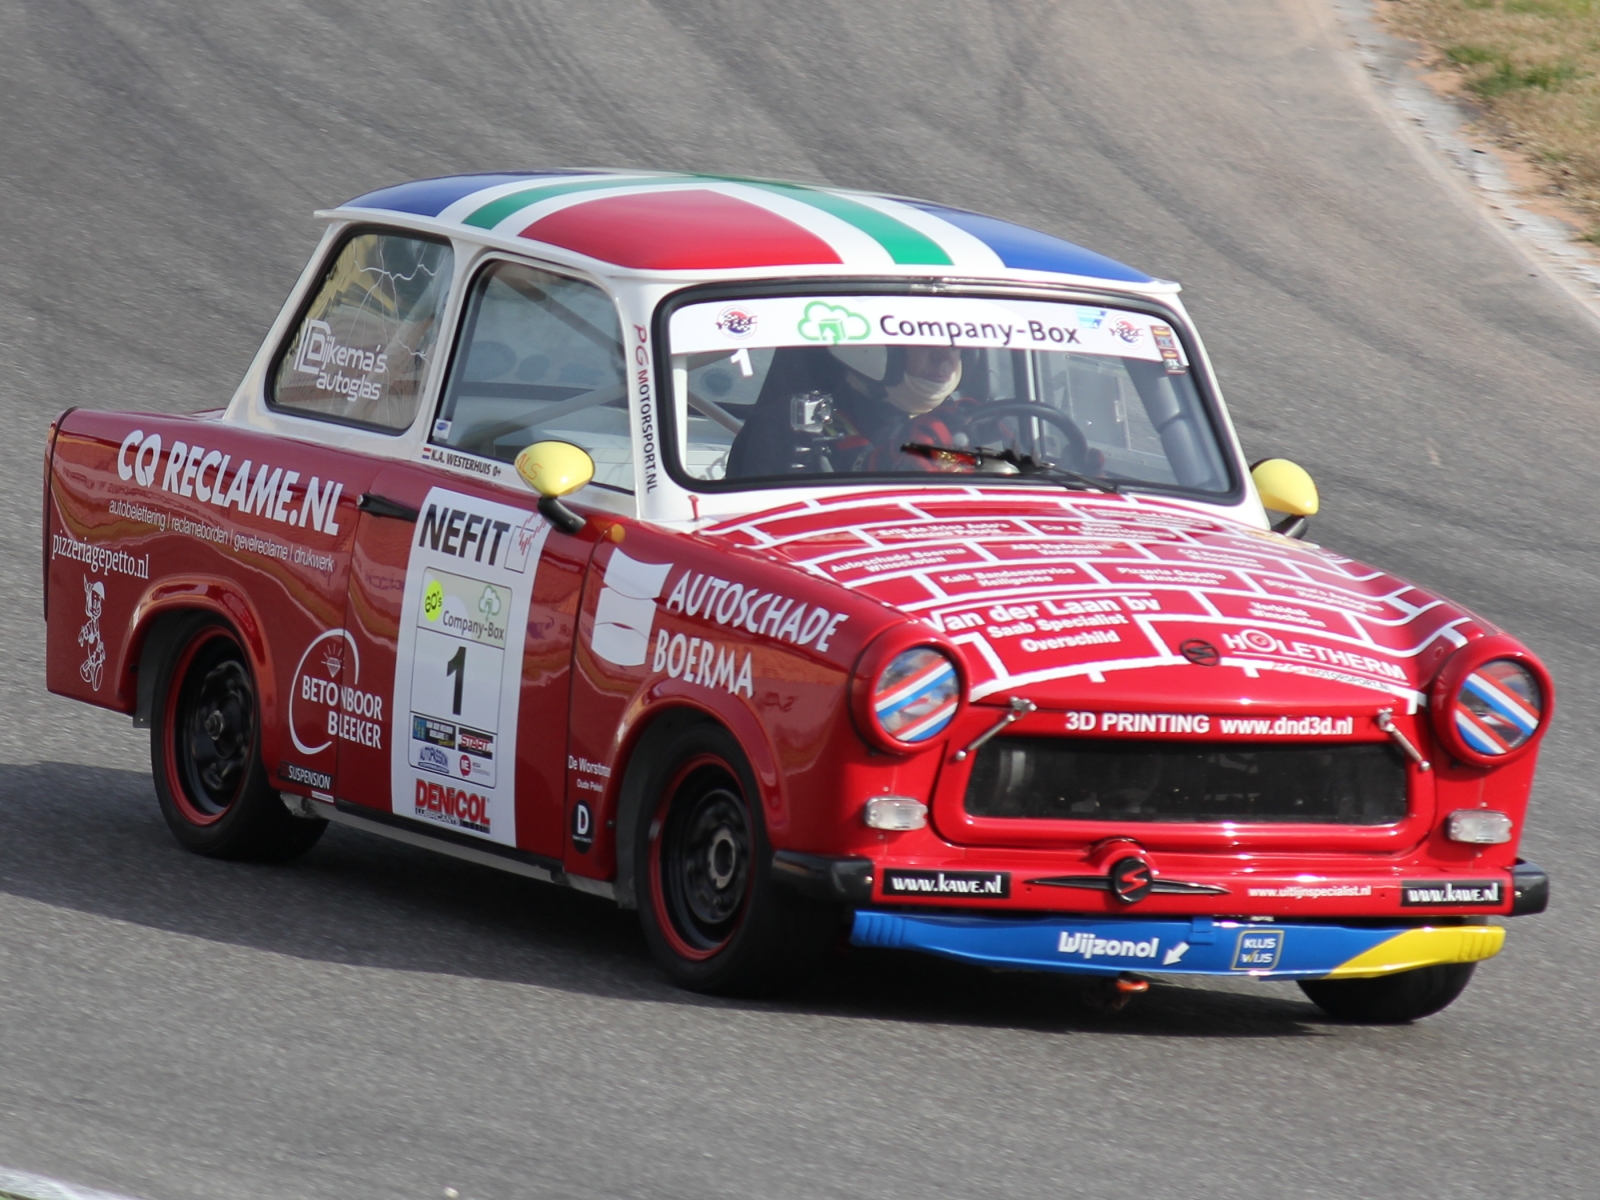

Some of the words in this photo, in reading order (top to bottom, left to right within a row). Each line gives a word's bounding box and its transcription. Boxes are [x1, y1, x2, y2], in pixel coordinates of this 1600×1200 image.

[880, 314, 1081, 346] Company-Box
[730, 348, 753, 376] 1
[316, 371, 382, 402] autoglas
[446, 453, 491, 475] WESTERHUIS
[117, 429, 162, 488] CQ
[161, 440, 344, 536] RECLAME.NL
[108, 499, 166, 531] autobelettering
[171, 516, 229, 545] reclameborden
[233, 533, 288, 561] gevelreclame
[293, 546, 334, 572] drukwerk
[418, 503, 511, 566] NEFIT
[52, 529, 149, 579] pizzeriagepetto.nl
[831, 553, 911, 573] Autoschade
[864, 556, 948, 573] Winschoten
[973, 567, 1077, 579] Bandenservice
[1116, 567, 1174, 576] Pizzeria
[1172, 569, 1228, 580] Gepetto
[1138, 574, 1221, 585] Winschoten
[666, 568, 850, 652] AUTOSCHADE
[921, 609, 986, 634] Van
[988, 604, 1040, 623] der
[1043, 596, 1122, 616] Laan
[1121, 594, 1162, 611] bv
[442, 610, 505, 641] Company-Box
[986, 619, 1037, 639] Saab
[1038, 612, 1130, 631] Specialist
[1020, 630, 1122, 653] Overschild
[1221, 629, 1408, 681] HOLETHERM
[652, 629, 754, 699] BOERMA
[446, 646, 467, 716] 1
[302, 675, 383, 721] BETONBOOR
[328, 711, 382, 749] BLEEKER
[1065, 712, 1096, 731] 3D
[1101, 712, 1211, 735] PRINTING
[1221, 716, 1353, 736] www.dnd3d.nl
[568, 755, 578, 770] De
[288, 765, 331, 790] SUSPENSION
[578, 804, 589, 835] D
[1248, 885, 1372, 899] www.uitlijnspecialist.nl
[1058, 931, 1160, 959] Wijzonol
[1243, 938, 1277, 949] KLUS
